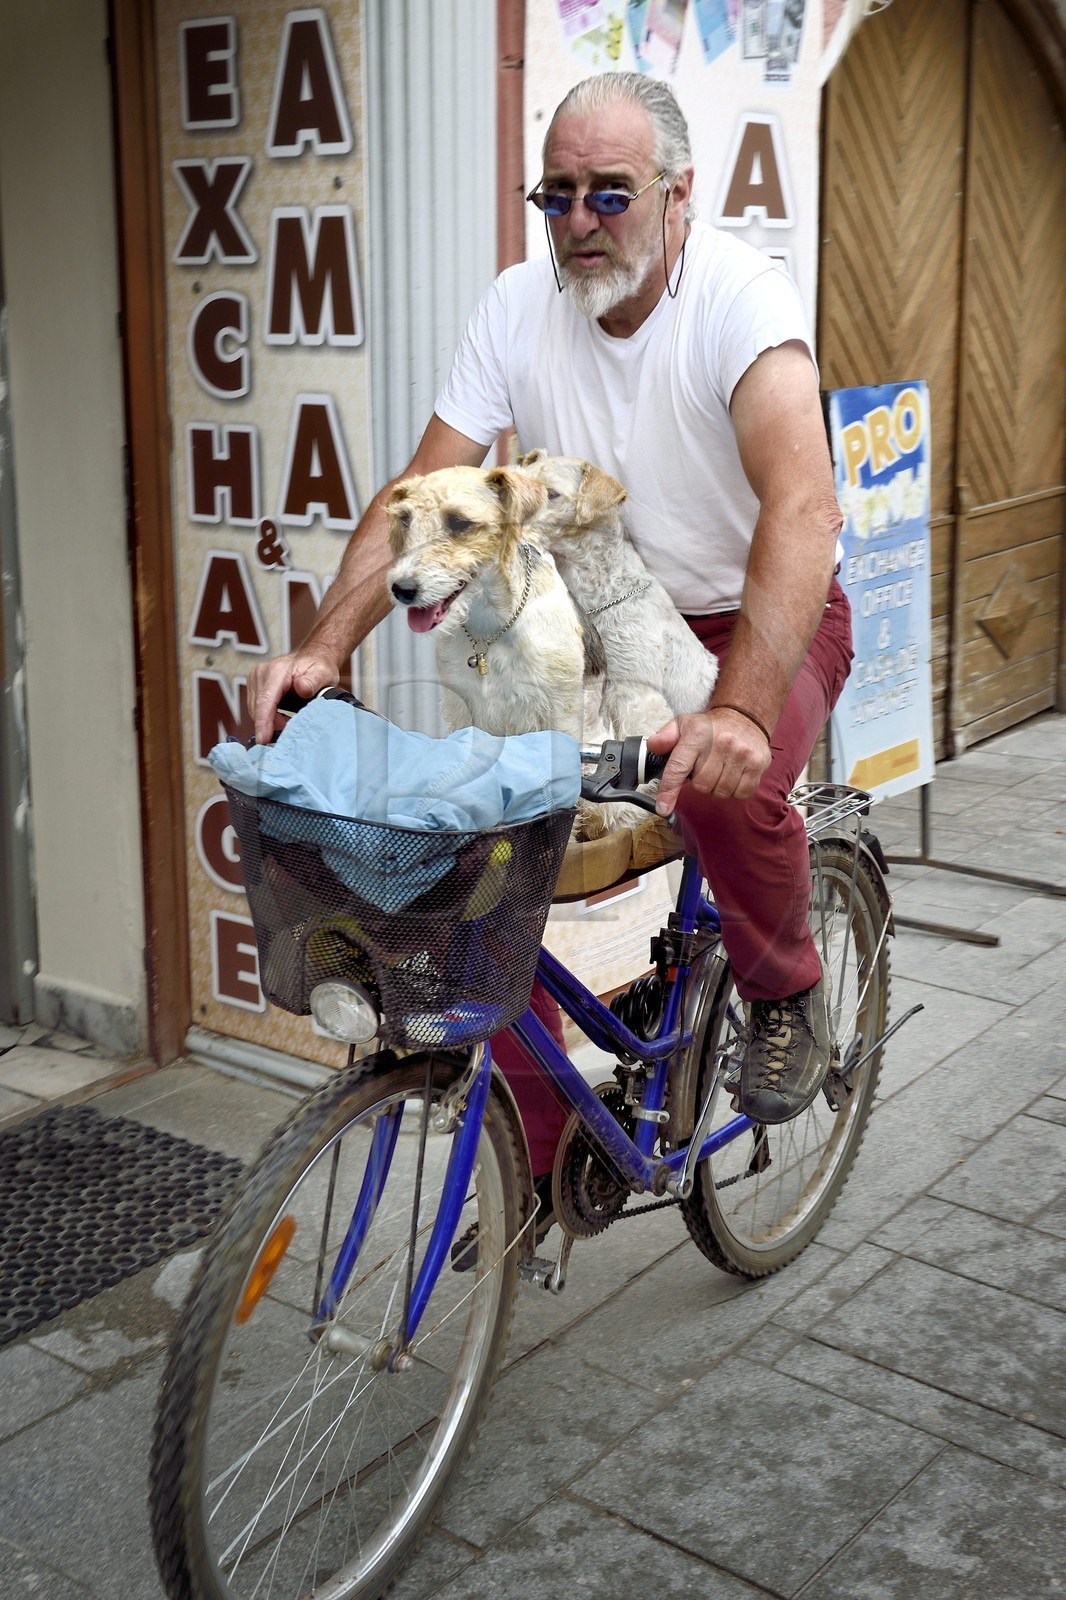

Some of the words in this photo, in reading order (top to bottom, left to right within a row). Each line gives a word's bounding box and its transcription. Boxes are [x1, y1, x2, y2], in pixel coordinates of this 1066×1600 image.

[840, 387, 924, 487] PRO
[257, 519, 289, 571] &
[847, 540, 925, 586] EXCHANGE
[862, 580, 912, 617] OFFICE
[877, 617, 891, 650] &
[896, 644, 918, 676] DE
[805, 1064, 821, 1091] SCARPA
